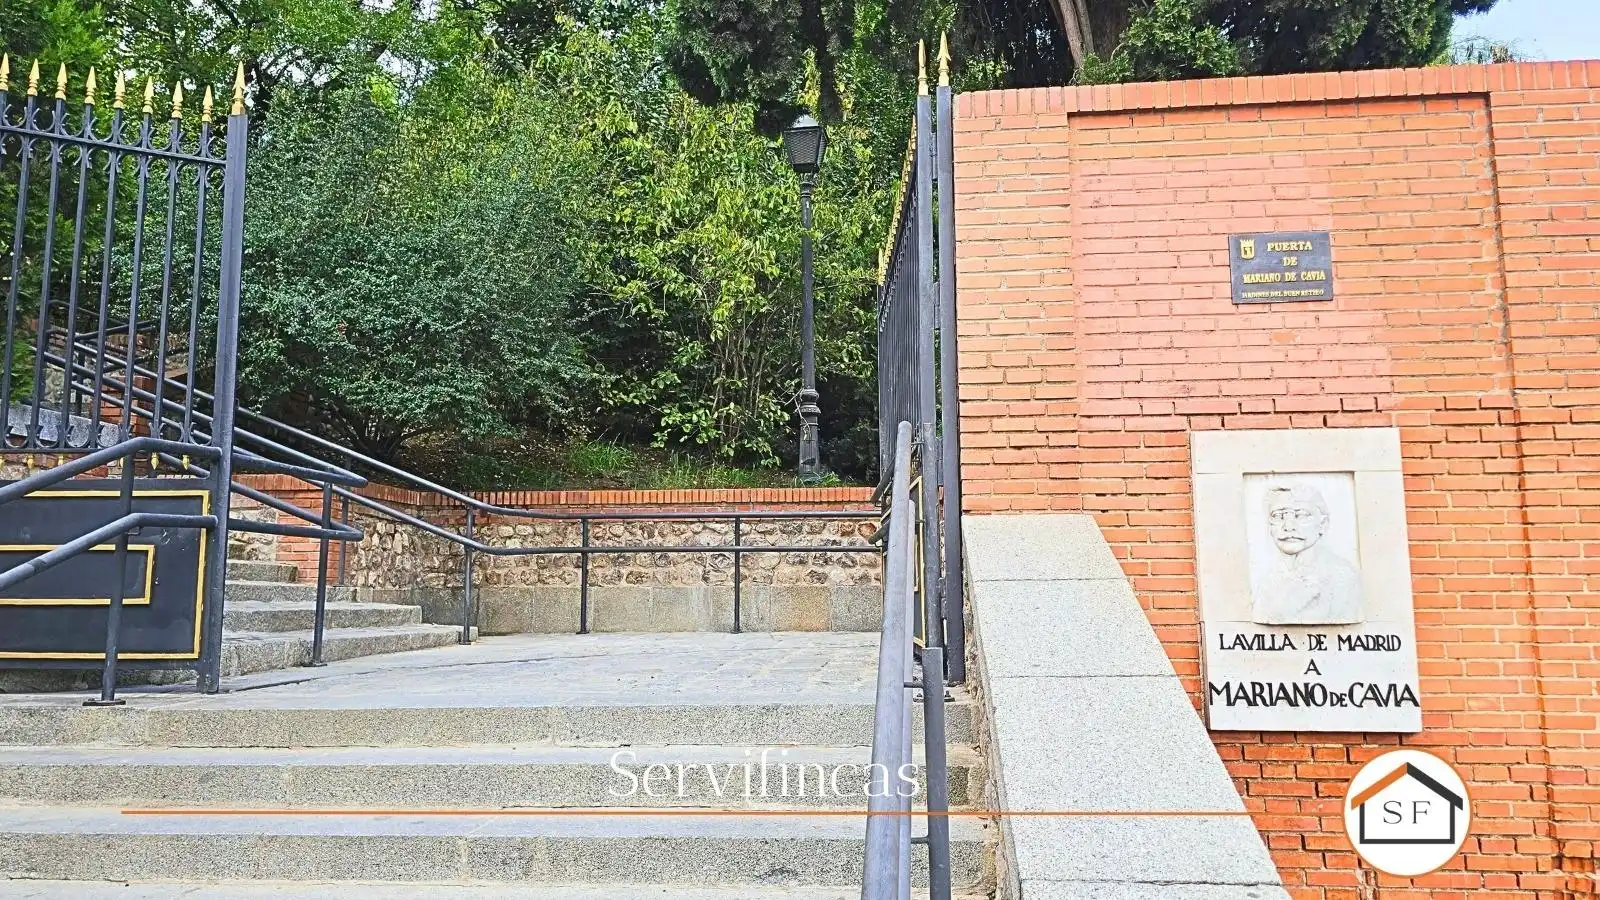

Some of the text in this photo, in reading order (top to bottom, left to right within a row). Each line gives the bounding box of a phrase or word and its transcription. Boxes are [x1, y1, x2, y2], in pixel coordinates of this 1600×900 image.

[1267, 241, 1313, 252] PUERTA
[1283, 256, 1298, 267] DE
[1243, 270, 1326, 284] MARIANO DE CAVIA
[1270, 290, 1283, 298] DEL
[1308, 634, 1328, 652] DE
[1337, 634, 1402, 652] MADRID
[1304, 658, 1322, 676] A
[1208, 681, 1420, 708] MARIANO DE CAVIA
